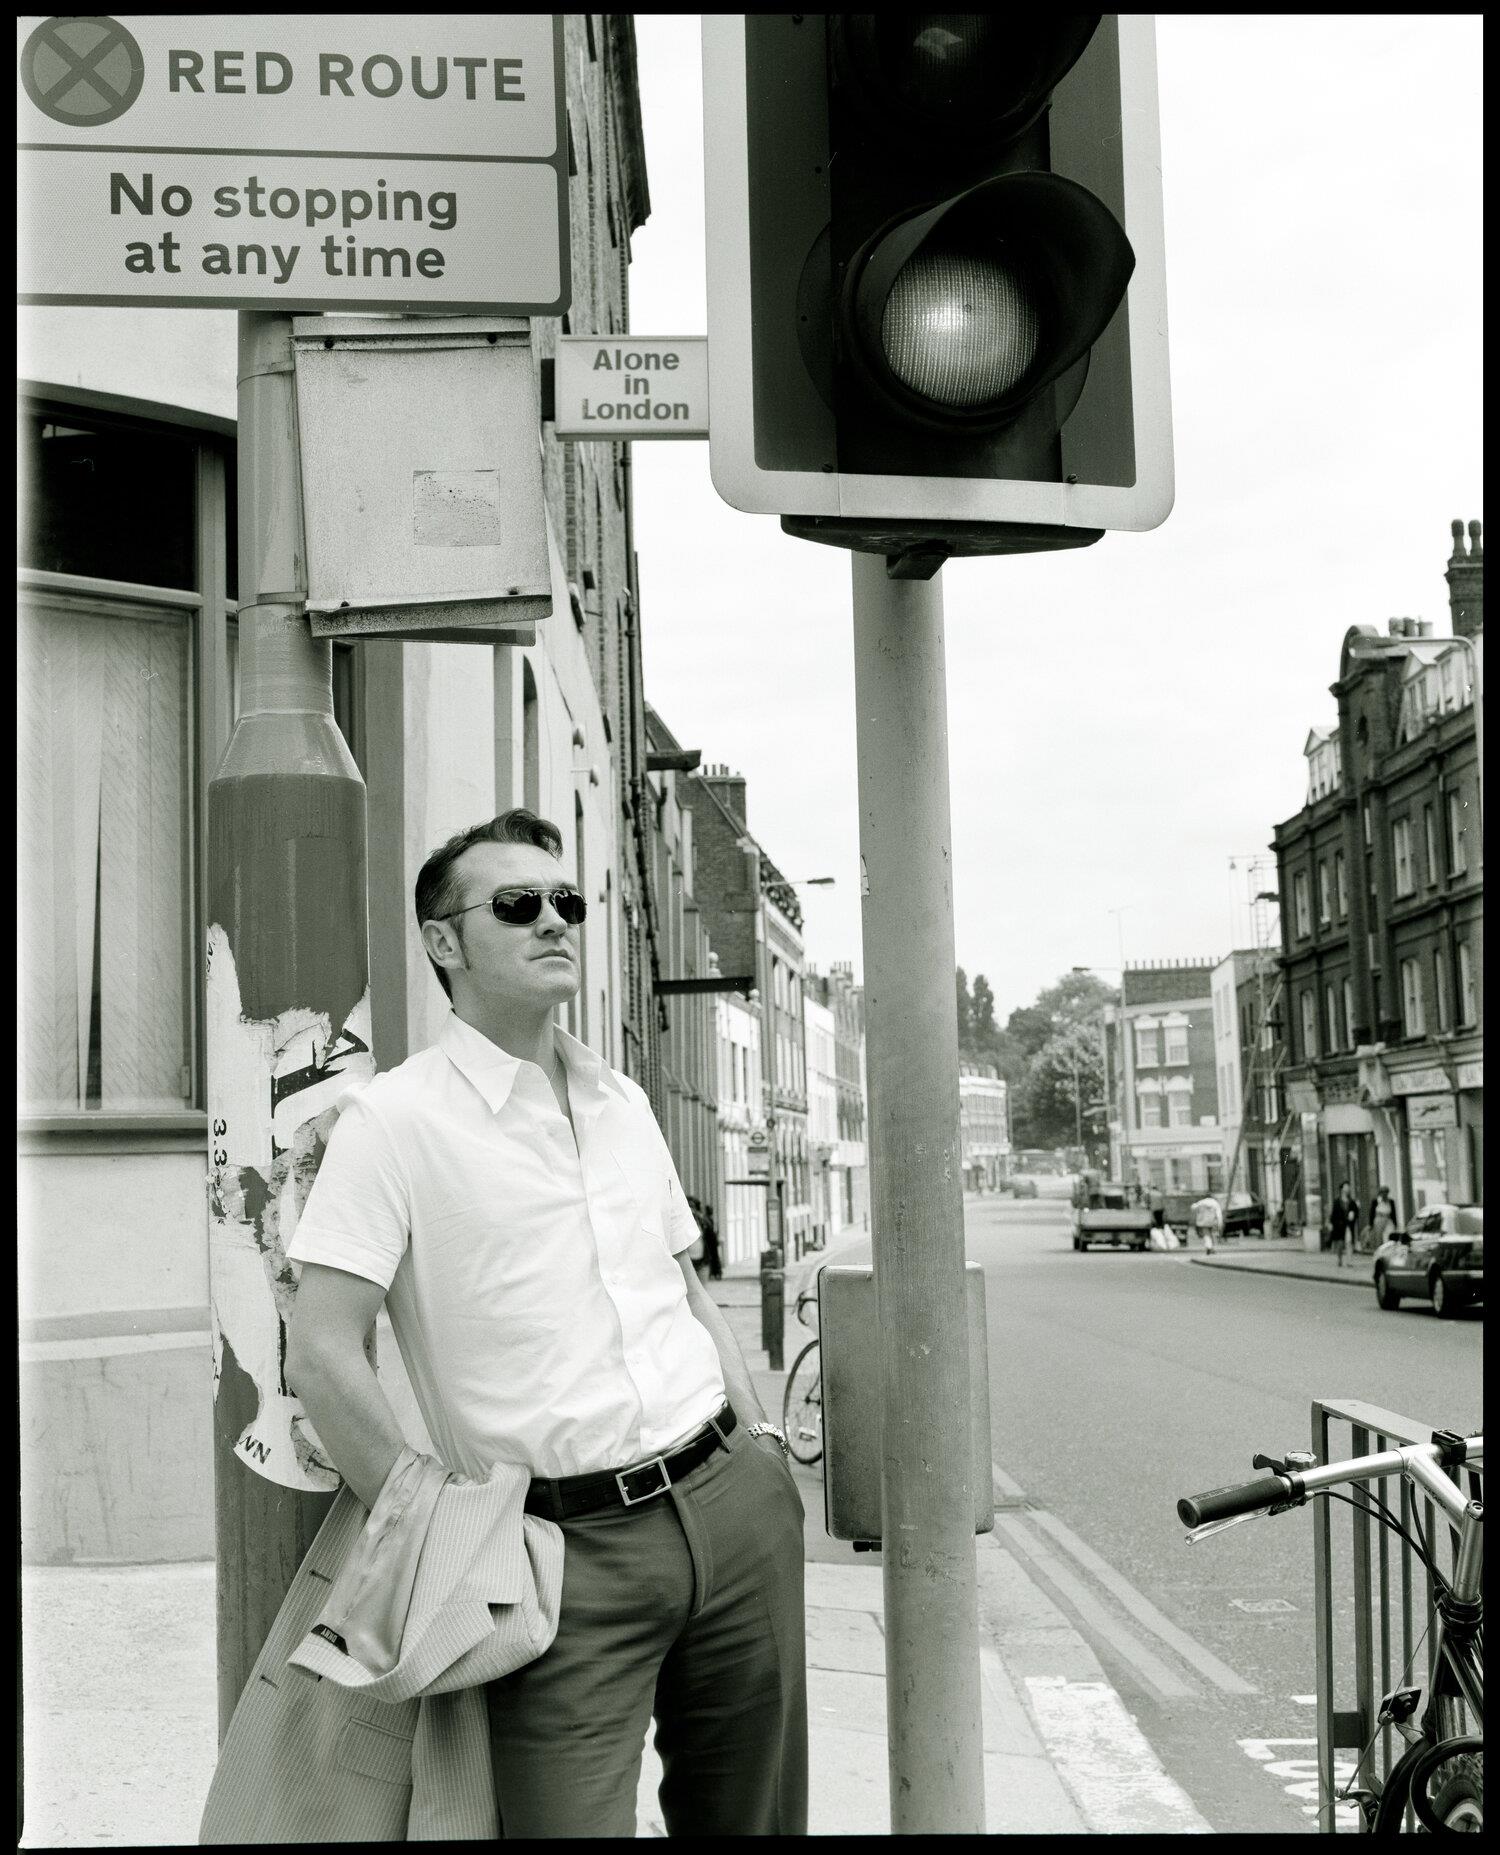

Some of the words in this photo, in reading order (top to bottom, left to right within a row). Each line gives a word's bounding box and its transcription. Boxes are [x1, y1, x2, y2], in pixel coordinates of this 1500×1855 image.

[168, 49, 294, 95] RED
[319, 53, 526, 102] ROUTE
[110, 172, 193, 217] No
[213, 176, 458, 230] stopping
[124, 231, 182, 274] at
[201, 243, 301, 285] any
[320, 234, 446, 279] time
[592, 348, 680, 371] Alone
[624, 373, 650, 395] in
[581, 398, 690, 421] London
